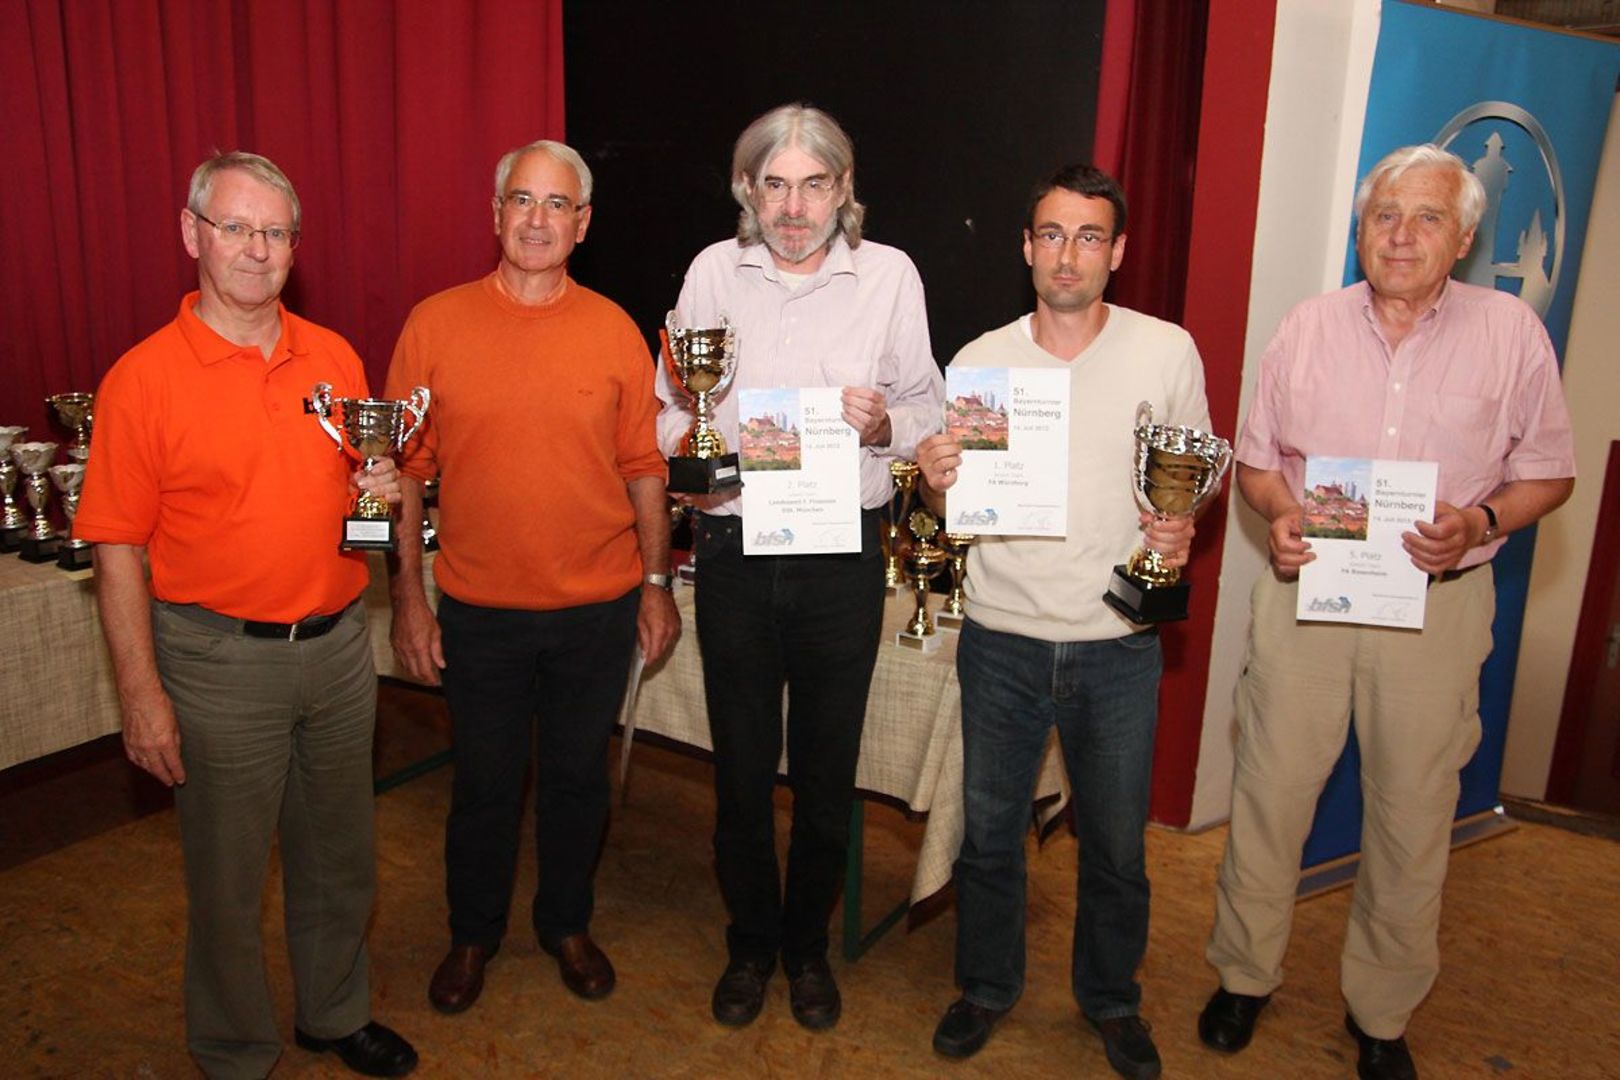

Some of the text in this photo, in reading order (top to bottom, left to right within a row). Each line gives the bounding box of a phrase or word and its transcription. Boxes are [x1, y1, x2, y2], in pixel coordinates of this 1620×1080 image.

[1013, 387, 1028, 396] 51.
[804, 407, 819, 416] 51.
[1013, 408, 1061, 419] Nürnberg
[804, 426, 851, 437] Nürnberg
[1004, 461, 1025, 470] Platz
[798, 480, 817, 489] Platz
[1376, 479, 1392, 488] 51.
[1375, 500, 1425, 512] Nürnberg
[1360, 551, 1382, 560] Platz
